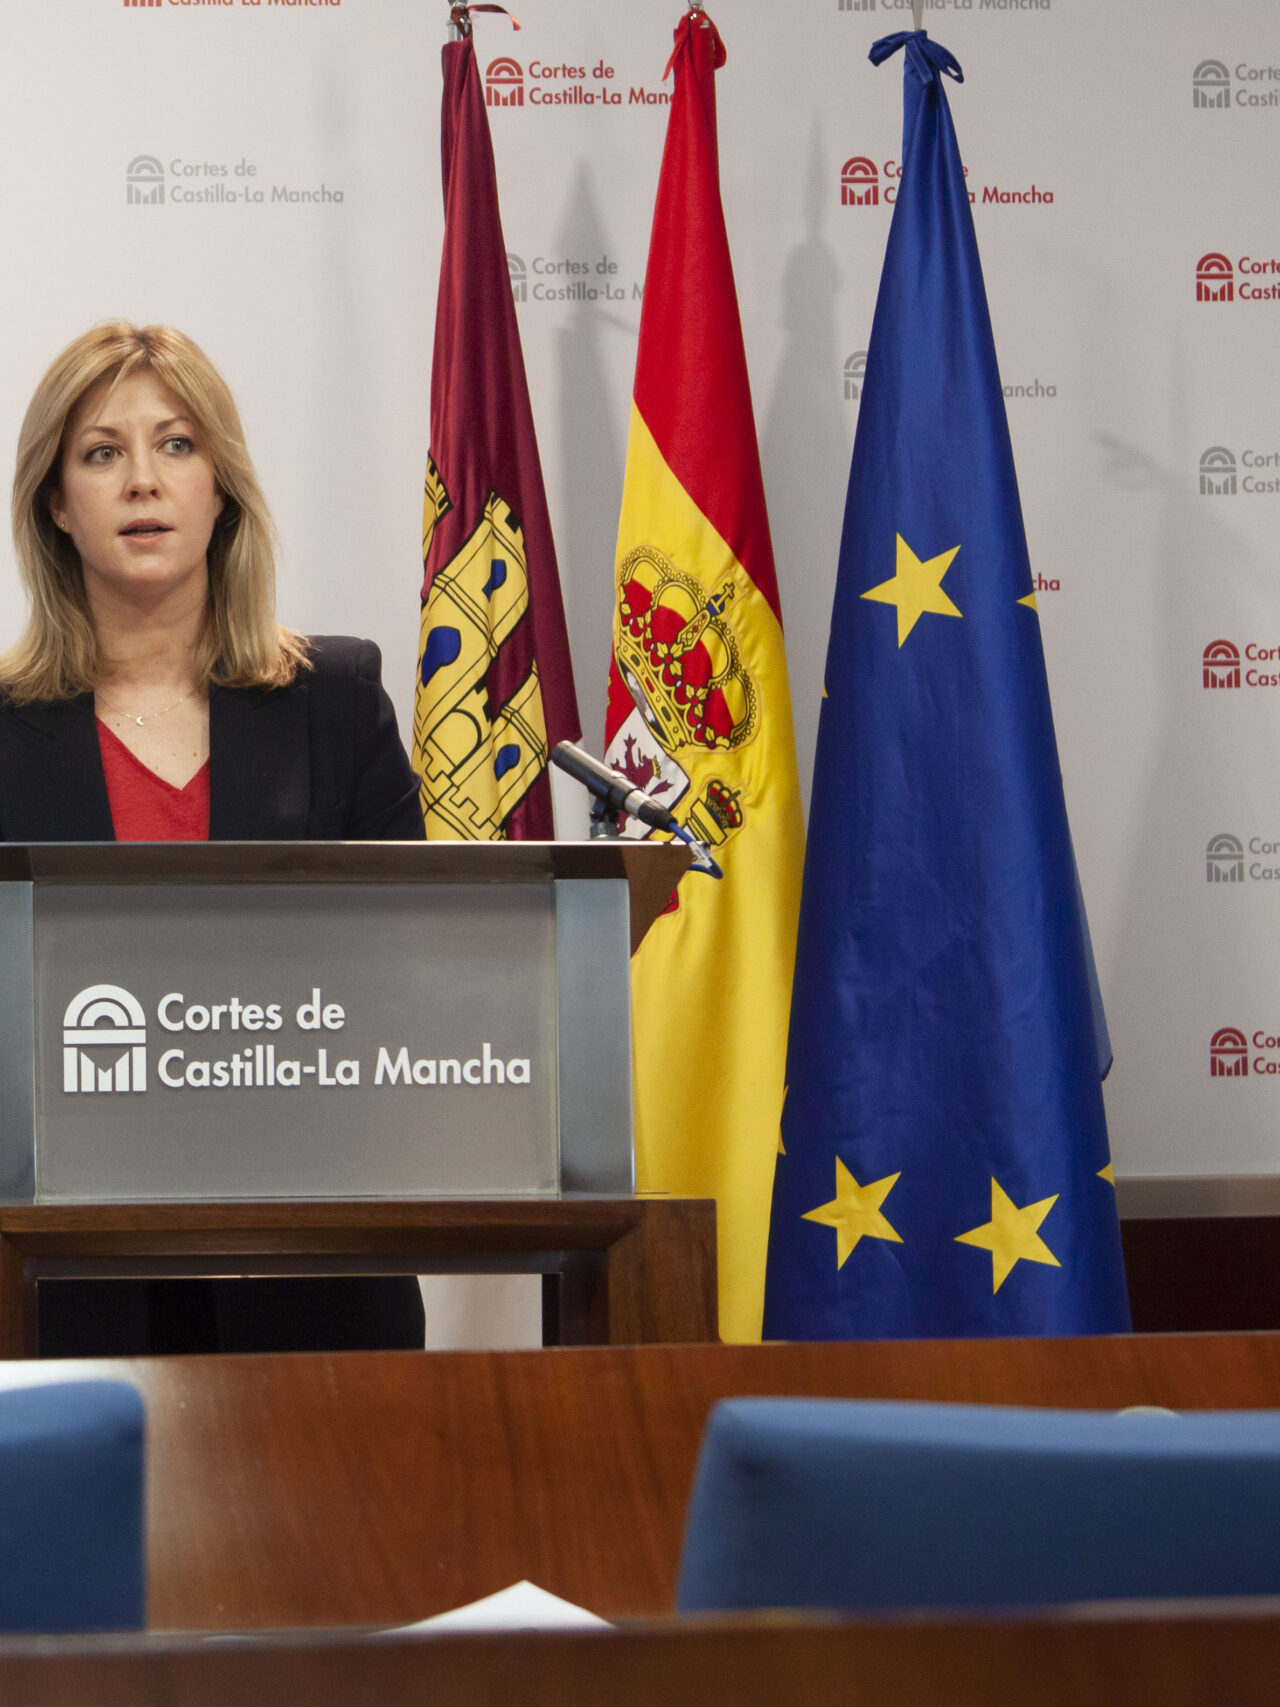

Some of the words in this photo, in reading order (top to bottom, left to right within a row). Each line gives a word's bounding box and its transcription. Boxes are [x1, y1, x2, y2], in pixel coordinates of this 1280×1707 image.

[529, 61, 586, 79] Cortes
[592, 60, 614, 78] de
[529, 86, 621, 104] Castilla-La
[170, 159, 227, 177] Cortes
[234, 157, 257, 177] de
[170, 184, 264, 203] Castilla-La
[272, 184, 344, 203] Mancha
[983, 185, 1053, 203] Mancha
[532, 257, 589, 274] Cortes
[596, 256, 618, 274] de
[533, 283, 625, 300] Castilla-La
[1005, 379, 1057, 397] ancha
[158, 993, 282, 1031] Cortes
[297, 988, 345, 1029] de
[158, 1045, 359, 1087] Castilla-La
[375, 1043, 530, 1084] Mancha
